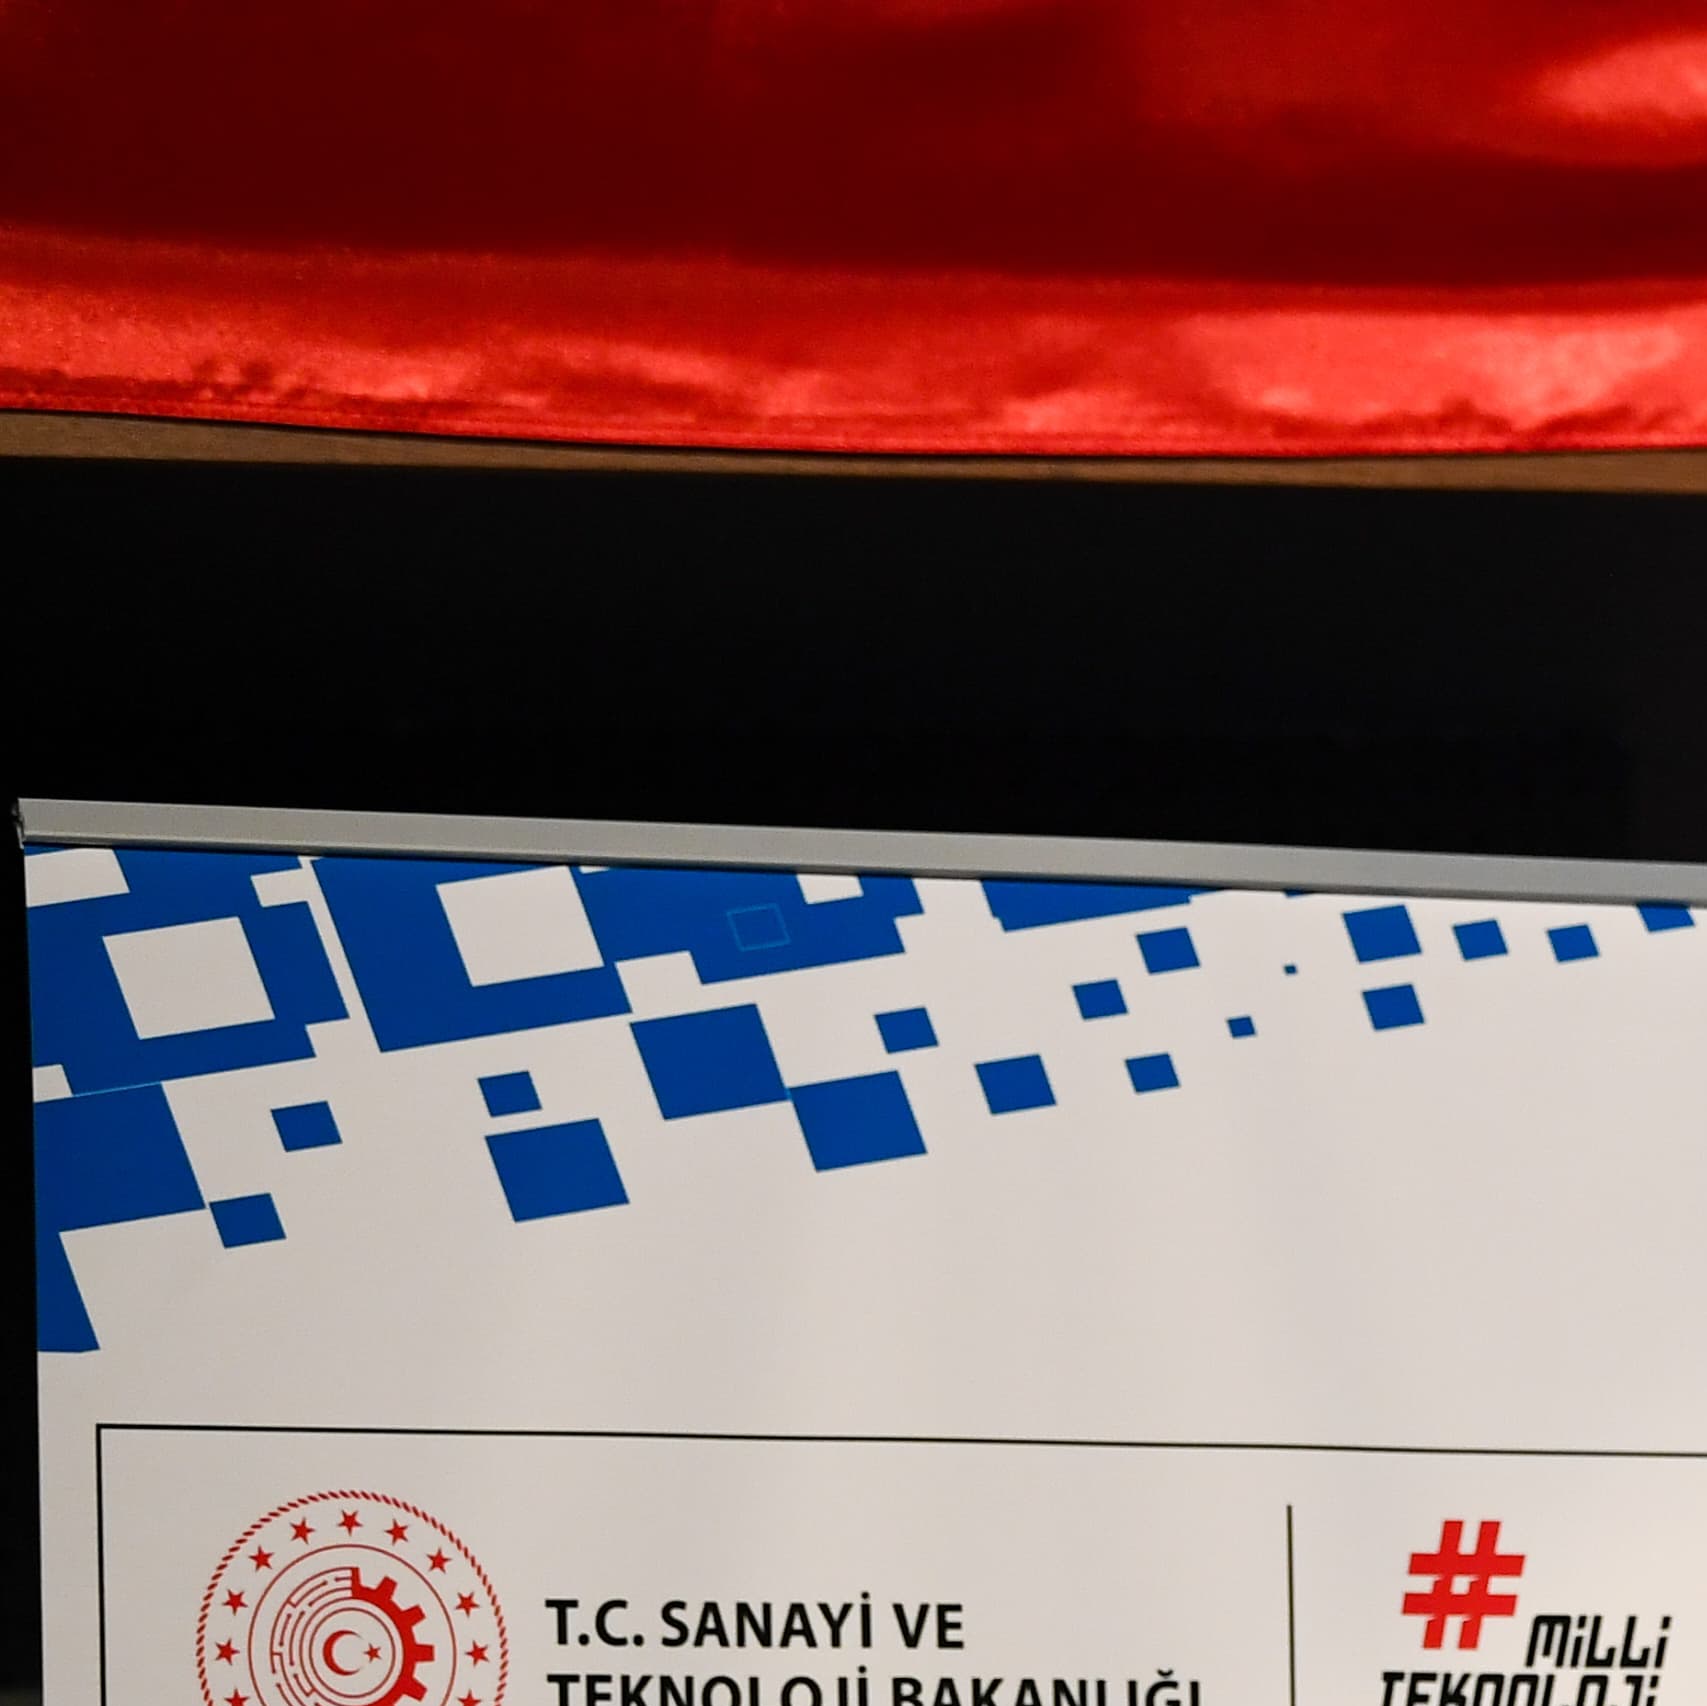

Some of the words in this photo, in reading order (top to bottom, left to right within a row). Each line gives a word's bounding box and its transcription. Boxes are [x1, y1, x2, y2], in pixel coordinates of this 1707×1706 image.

[545, 1598, 645, 1647] T.C.
[660, 1591, 872, 1648] SANAYİ
[892, 1602, 965, 1649] VE
